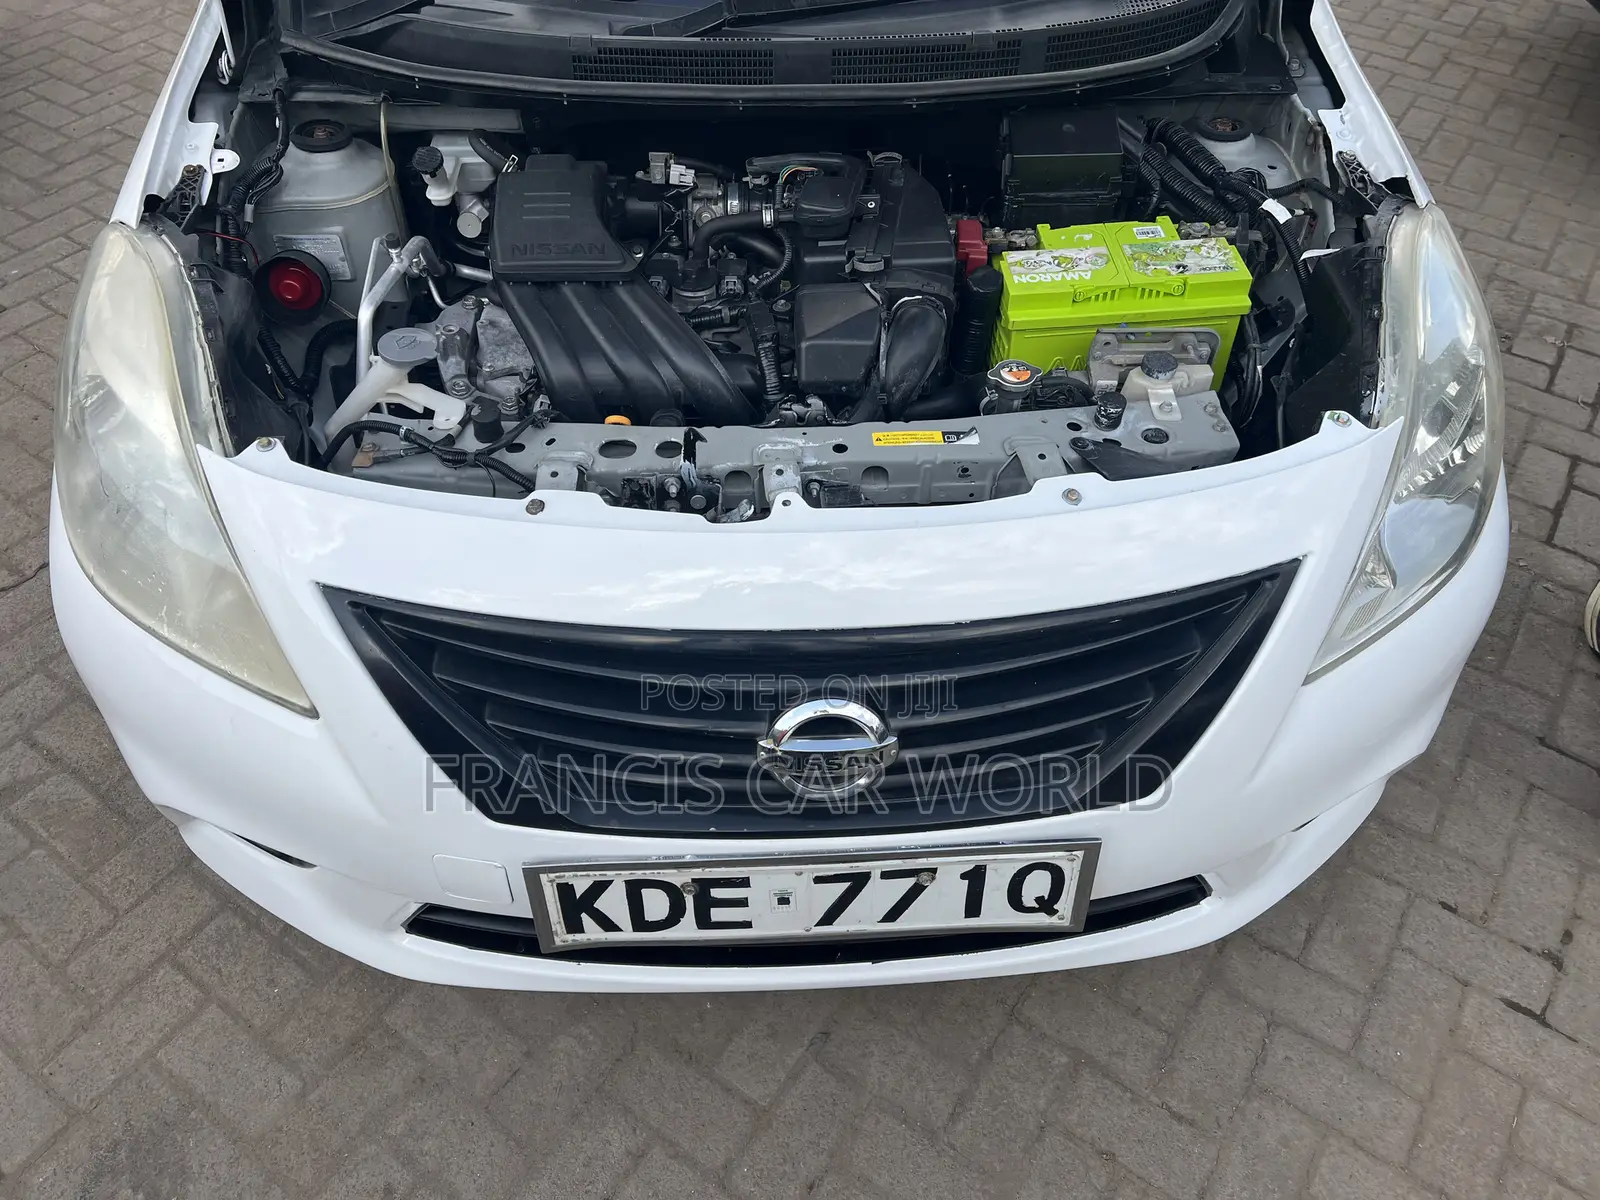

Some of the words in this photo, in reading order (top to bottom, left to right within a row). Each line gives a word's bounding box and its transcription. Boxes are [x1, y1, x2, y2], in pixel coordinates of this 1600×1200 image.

[511, 243, 606, 256] NISSAN
[1013, 270, 1093, 285] AMARON
[555, 876, 753, 935] KDE
[812, 861, 1067, 927] 771Q
